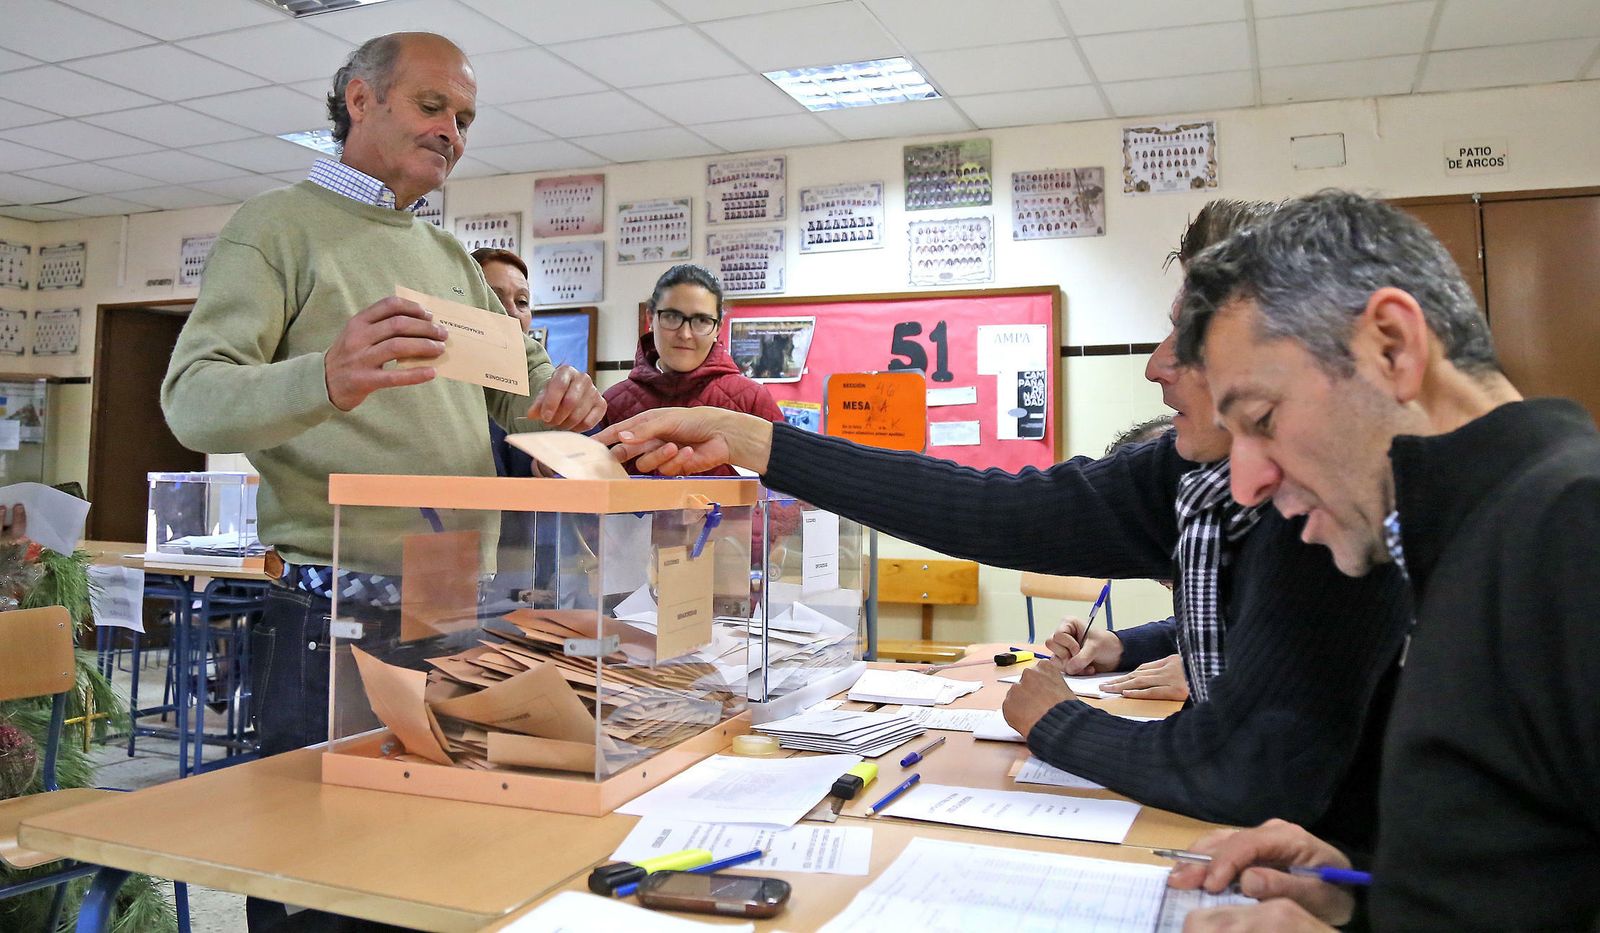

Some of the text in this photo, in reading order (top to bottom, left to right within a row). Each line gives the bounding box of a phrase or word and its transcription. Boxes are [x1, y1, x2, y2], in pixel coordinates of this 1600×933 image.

[1459, 146, 1492, 157] PATIO
[1448, 157, 1504, 169] DE ARCOS
[994, 332, 1031, 344] AMPA
[888, 320, 954, 382] 51
[484, 373, 519, 386] ELECCIONES
[1024, 371, 1045, 380] CAM
[1018, 378, 1045, 388] PAÑA
[1032, 385, 1045, 393] DE
[1023, 391, 1045, 400] NAVI
[842, 401, 871, 410] MESA
[1024, 399, 1045, 407] DAD
